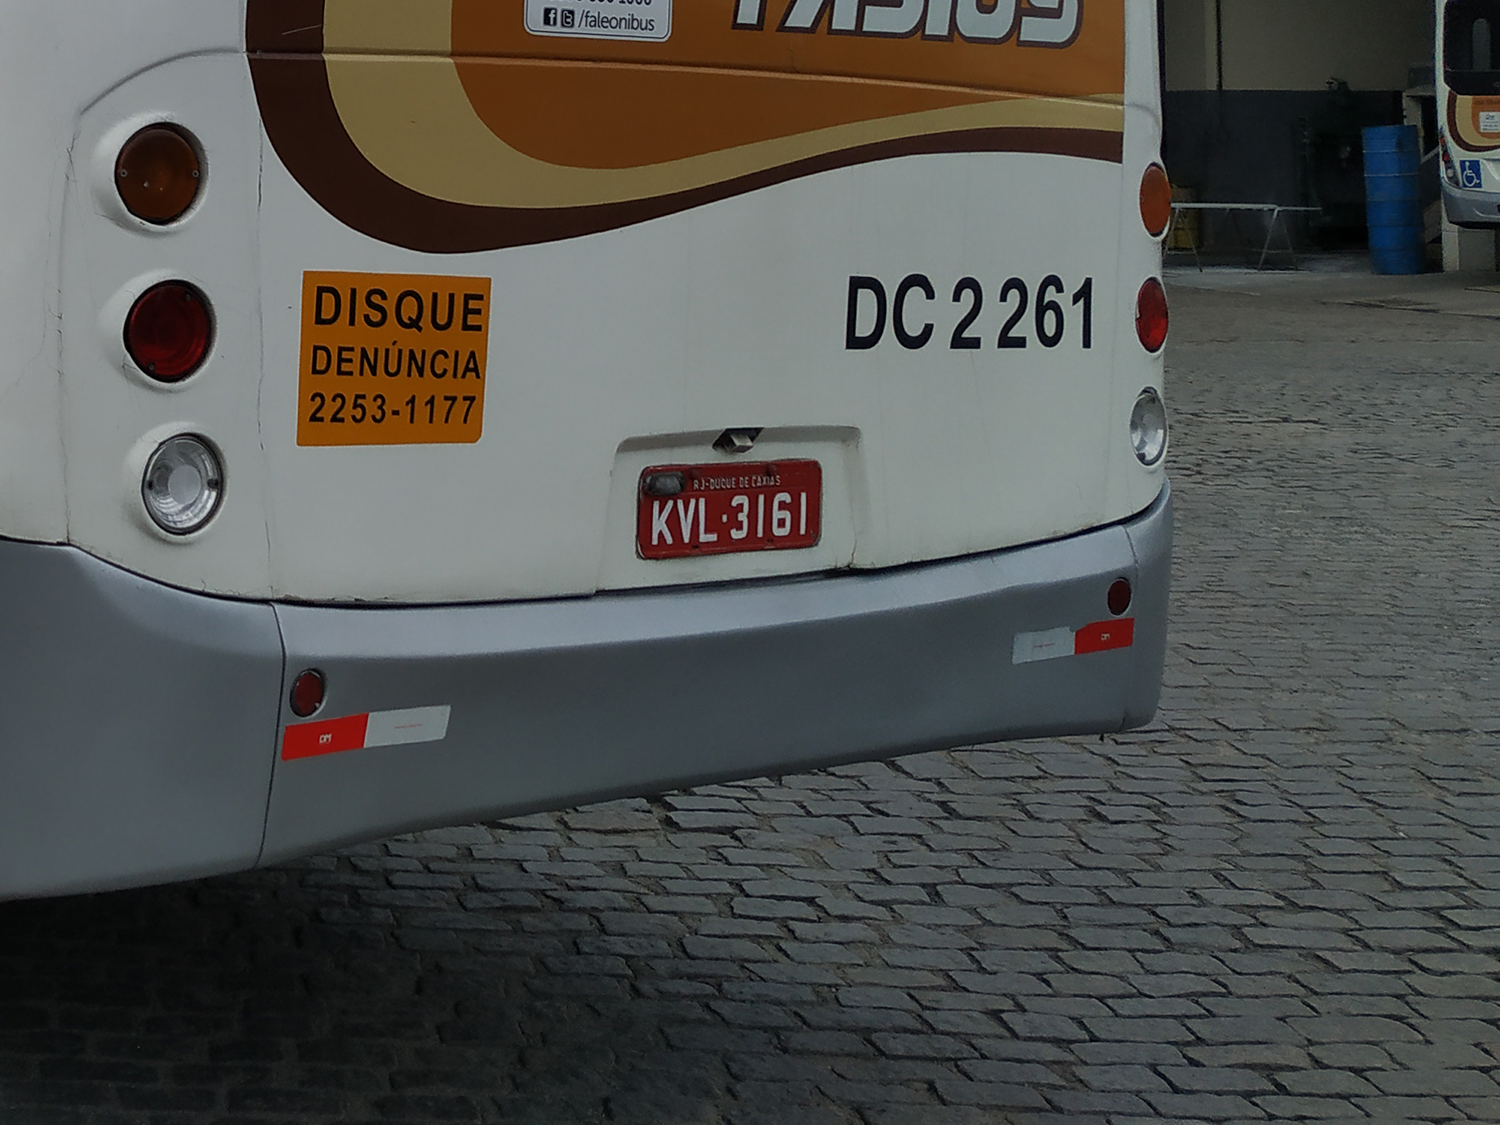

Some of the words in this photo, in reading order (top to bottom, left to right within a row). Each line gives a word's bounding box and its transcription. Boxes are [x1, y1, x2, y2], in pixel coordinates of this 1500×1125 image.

[578, 9, 655, 31] /faleonibus
[314, 285, 484, 333] DISQUE
[845, 273, 936, 350] DC
[311, 340, 481, 380] DENÚNCIA
[308, 392, 476, 424] 2253-1177
[739, 476, 750, 488] DE
[751, 475, 781, 488] CAXIAS
